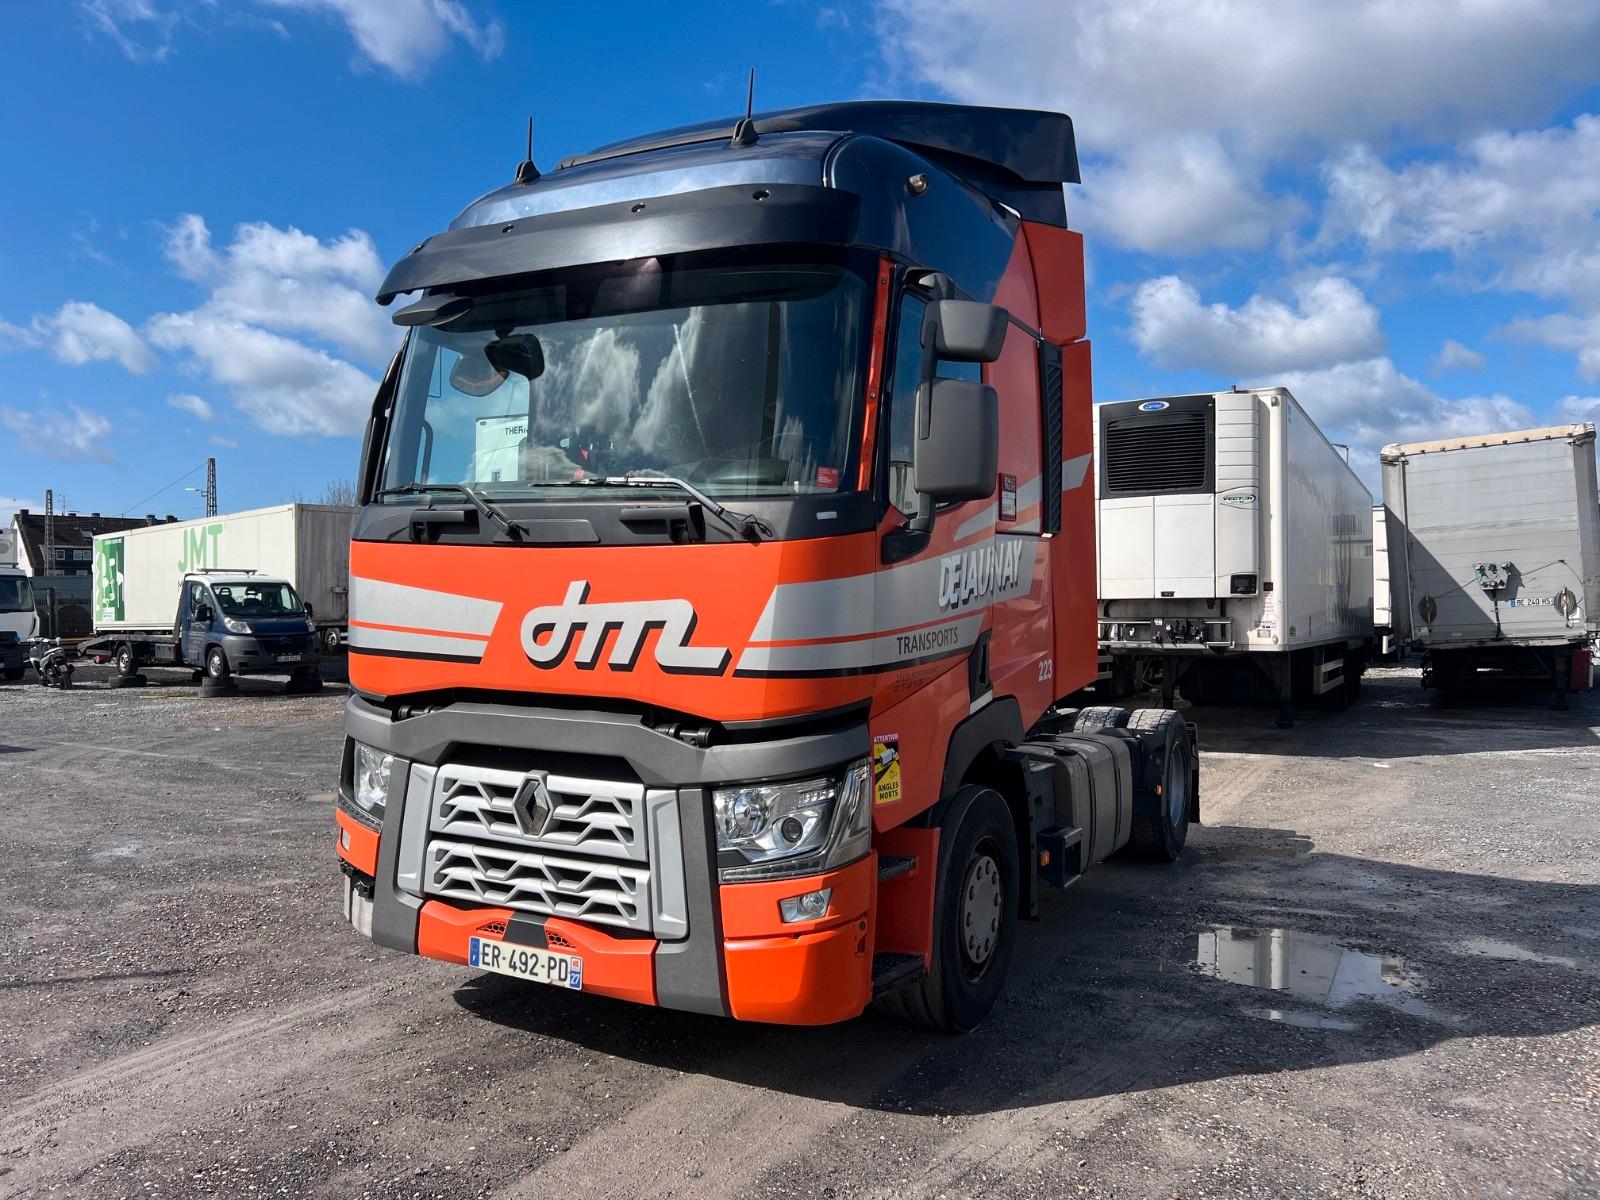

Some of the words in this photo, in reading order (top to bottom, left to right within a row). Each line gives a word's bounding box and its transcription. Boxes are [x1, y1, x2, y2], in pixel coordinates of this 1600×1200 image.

[178, 523, 223, 574] JMT
[938, 539, 1022, 609] DELAUNAY
[1527, 598, 1540, 606] 240
[897, 627, 959, 655] TRANSPORTS
[1038, 659, 1053, 682] 223
[873, 733, 899, 743] ATTENTION
[878, 781, 899, 793] ANGLES
[879, 790, 899, 800] MORTS
[482, 943, 568, 982] ER-492-PD
[570, 973, 580, 985] 27
